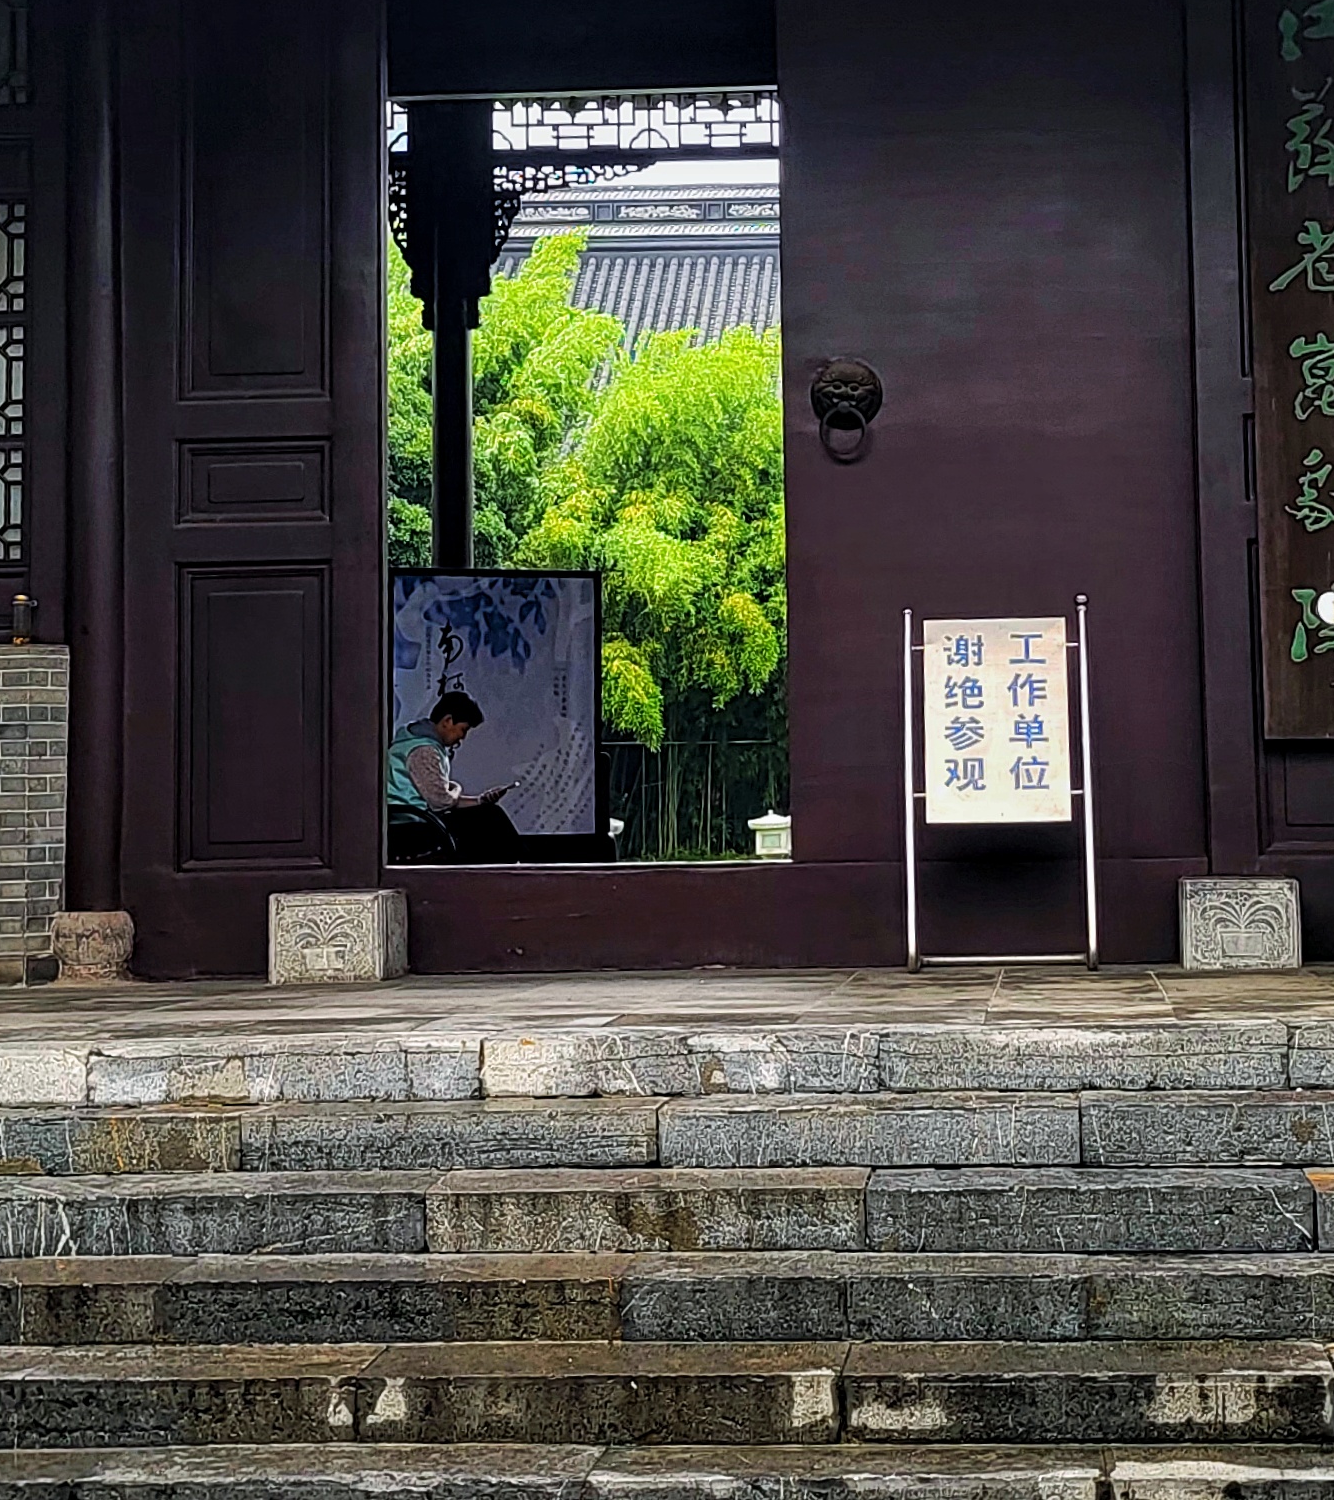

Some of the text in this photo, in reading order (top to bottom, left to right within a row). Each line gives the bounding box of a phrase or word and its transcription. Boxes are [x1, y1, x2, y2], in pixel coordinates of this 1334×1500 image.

[943, 634, 987, 792] 谢绝参观
[1007, 633, 1050, 791] 工作单位
